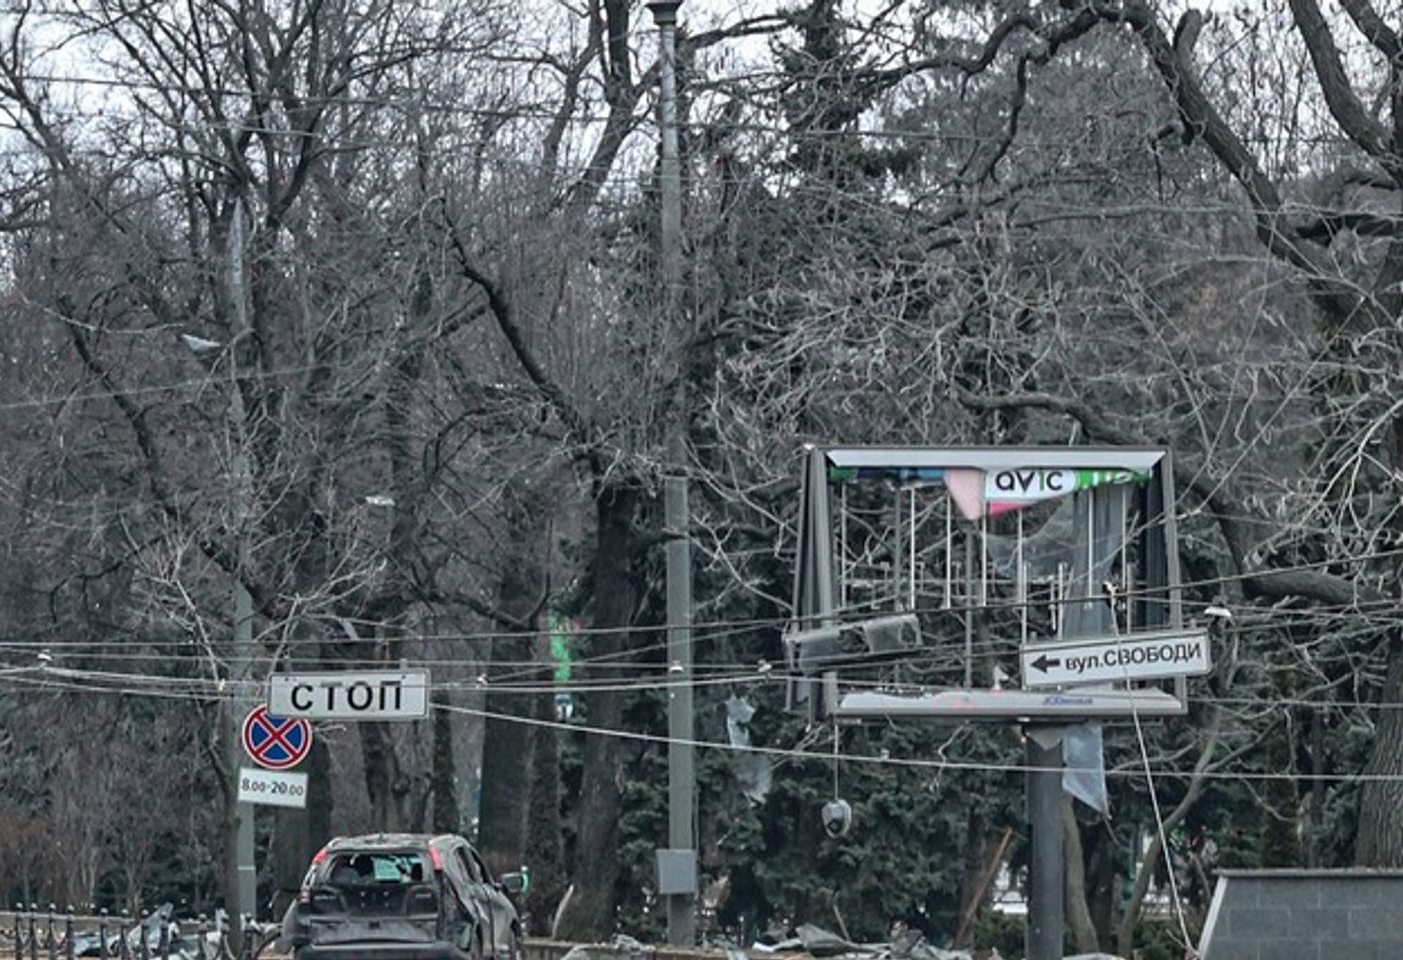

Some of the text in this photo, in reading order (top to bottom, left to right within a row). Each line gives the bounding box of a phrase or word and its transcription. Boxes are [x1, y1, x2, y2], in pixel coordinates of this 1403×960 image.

[1065, 642, 1202, 674] вул.СВОБОДИ
[291, 680, 401, 711] СТОП
[241, 778, 304, 796] 8.00-20.00
